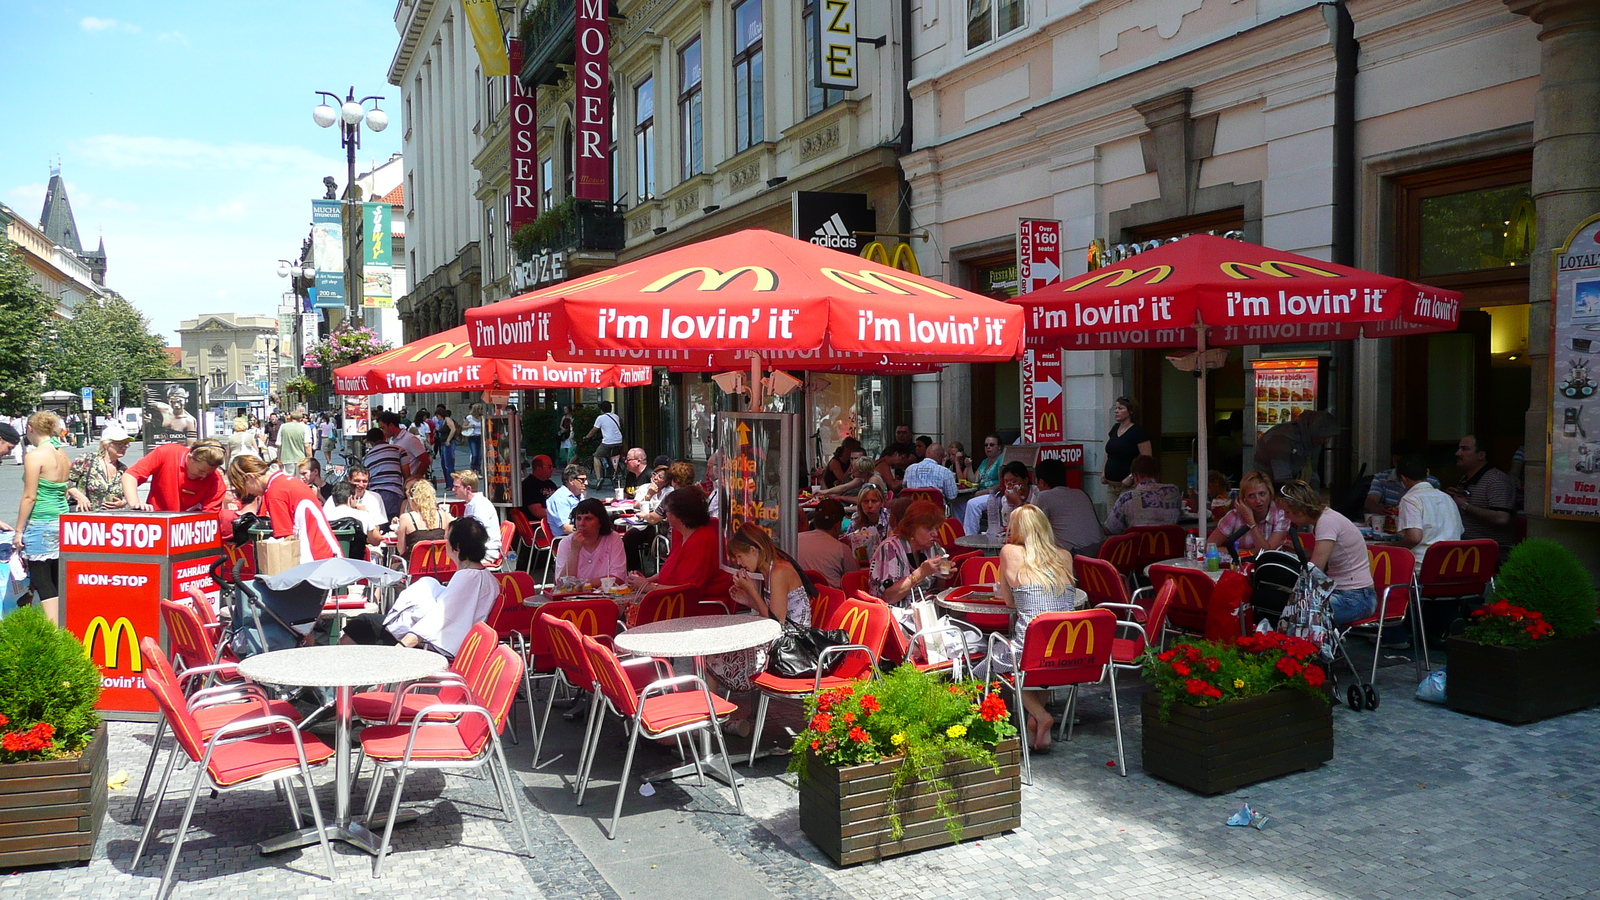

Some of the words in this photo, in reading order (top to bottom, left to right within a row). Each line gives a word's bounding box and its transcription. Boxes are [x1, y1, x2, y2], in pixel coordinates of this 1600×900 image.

[580, 0, 605, 158] MOSER
[513, 75, 535, 207] MOSER
[372, 205, 384, 259] SUBWAY
[810, 234, 857, 248] adidas
[1034, 233, 1057, 244] 160
[1560, 253, 1600, 269] LOYAL
[1033, 306, 1067, 329] i'm
[1074, 298, 1145, 327] lovin'
[1226, 291, 1270, 317] i'm
[1278, 288, 1356, 315] lovin'
[1414, 292, 1431, 317] i'm
[1432, 295, 1453, 321] lovin'
[476, 320, 495, 347] i'm
[498, 313, 535, 345] lovin'
[598, 308, 649, 339] i'm
[660, 308, 761, 339] lovin'
[858, 309, 901, 341] i'm
[908, 312, 980, 344] lovin'
[386, 374, 412, 388] i'm
[416, 365, 464, 386] lovin'
[512, 364, 540, 382] i'm
[543, 366, 588, 382] lovin'
[1041, 448, 1082, 463] NON-STOP
[64, 521, 162, 548] NON-STOP
[171, 519, 218, 548] NON-STOP
[78, 574, 148, 587] NON-STOP
[180, 582, 190, 592] VE
[100, 676, 135, 688] ovin'
